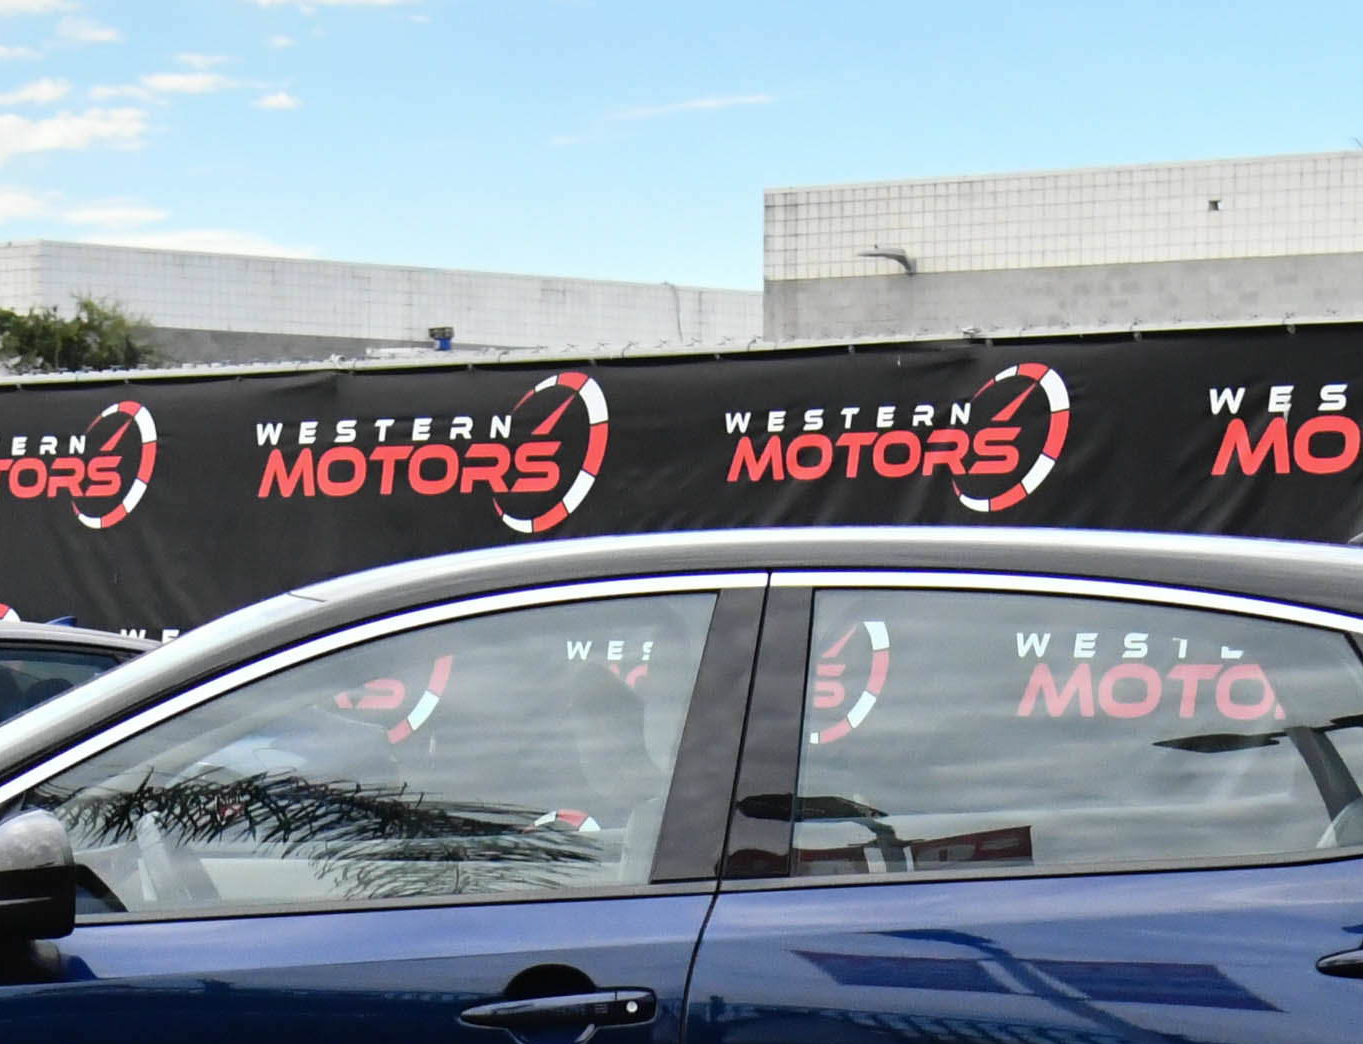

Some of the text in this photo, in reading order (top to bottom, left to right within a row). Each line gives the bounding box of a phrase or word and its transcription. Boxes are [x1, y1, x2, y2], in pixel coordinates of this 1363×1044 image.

[256, 414, 512, 446] WESTERN
[725, 402, 971, 434] WESTERN
[257, 439, 562, 499] MOTORS
[727, 425, 1022, 484] MOTORS
[1016, 663, 1287, 720] MOTO
